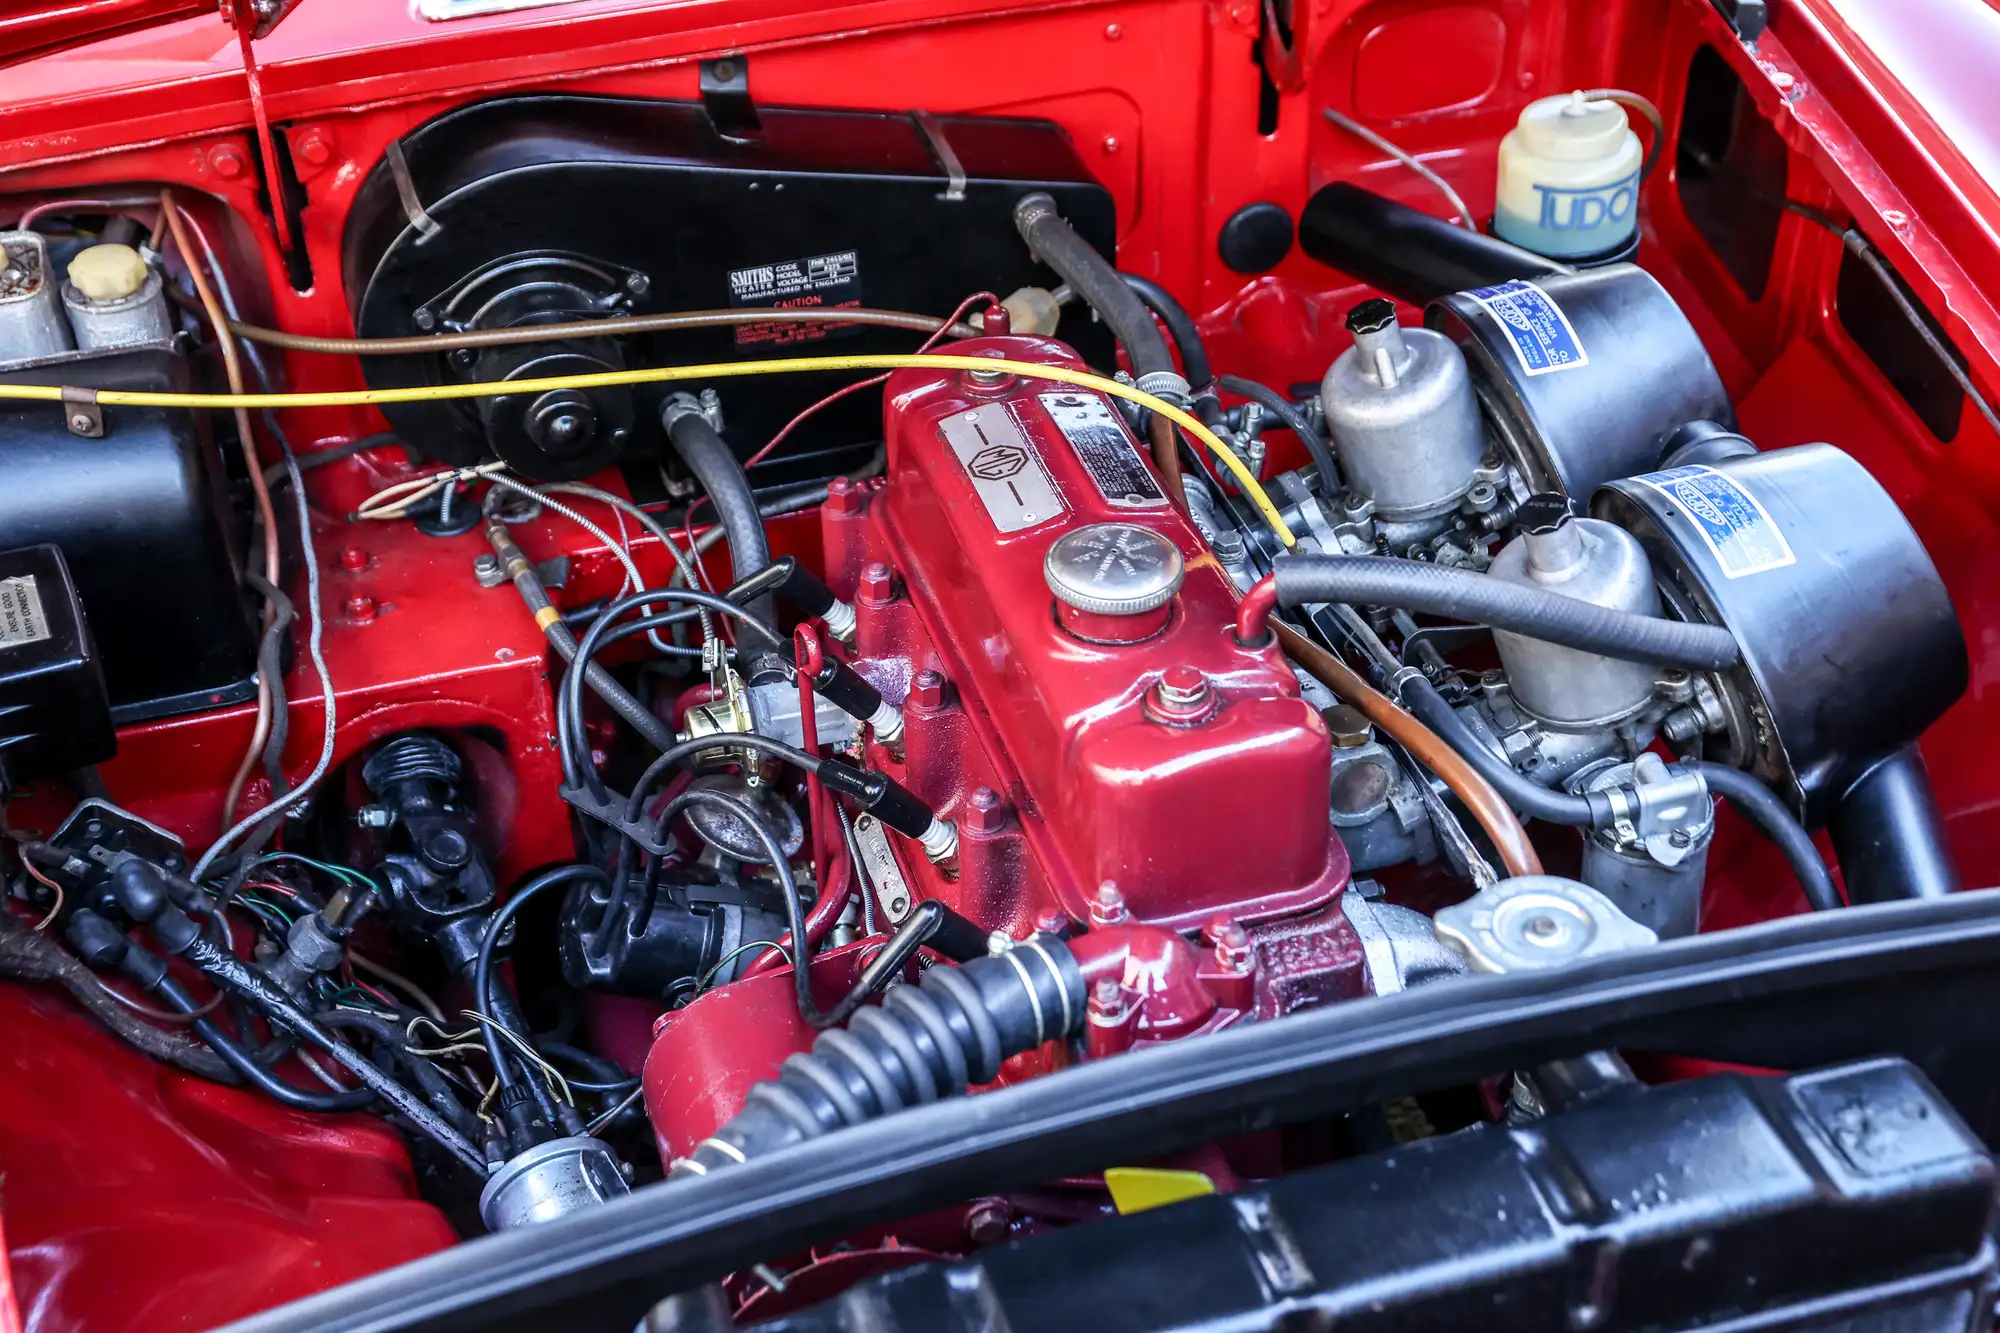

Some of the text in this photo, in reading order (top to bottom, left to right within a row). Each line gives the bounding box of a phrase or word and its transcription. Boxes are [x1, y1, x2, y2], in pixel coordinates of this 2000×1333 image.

[731, 267, 774, 288] SMITHS
[775, 263, 797, 272] CODE
[776, 270, 801, 280] MODEL
[735, 282, 772, 295] HEATER
[741, 285, 801, 300] MANUFACTURED
[815, 276, 850, 289] ENGLAND
[777, 276, 808, 287] VOLTAGE
[774, 296, 822, 309] CAUTION
[1521, 307, 1532, 316] OF
[1529, 318, 1552, 345] SERVICE
[1535, 311, 1570, 363] TO VEHICLE
[1523, 335, 1542, 364] ENGLAND
[1548, 348, 1561, 365] FOR
[974, 449, 1024, 477] MG
[1678, 483, 1722, 523] COOPERS
[1711, 496, 1724, 507] OF
[2, 592, 19, 633] ENSURE GOOD
[23, 617, 36, 637] EARTH
